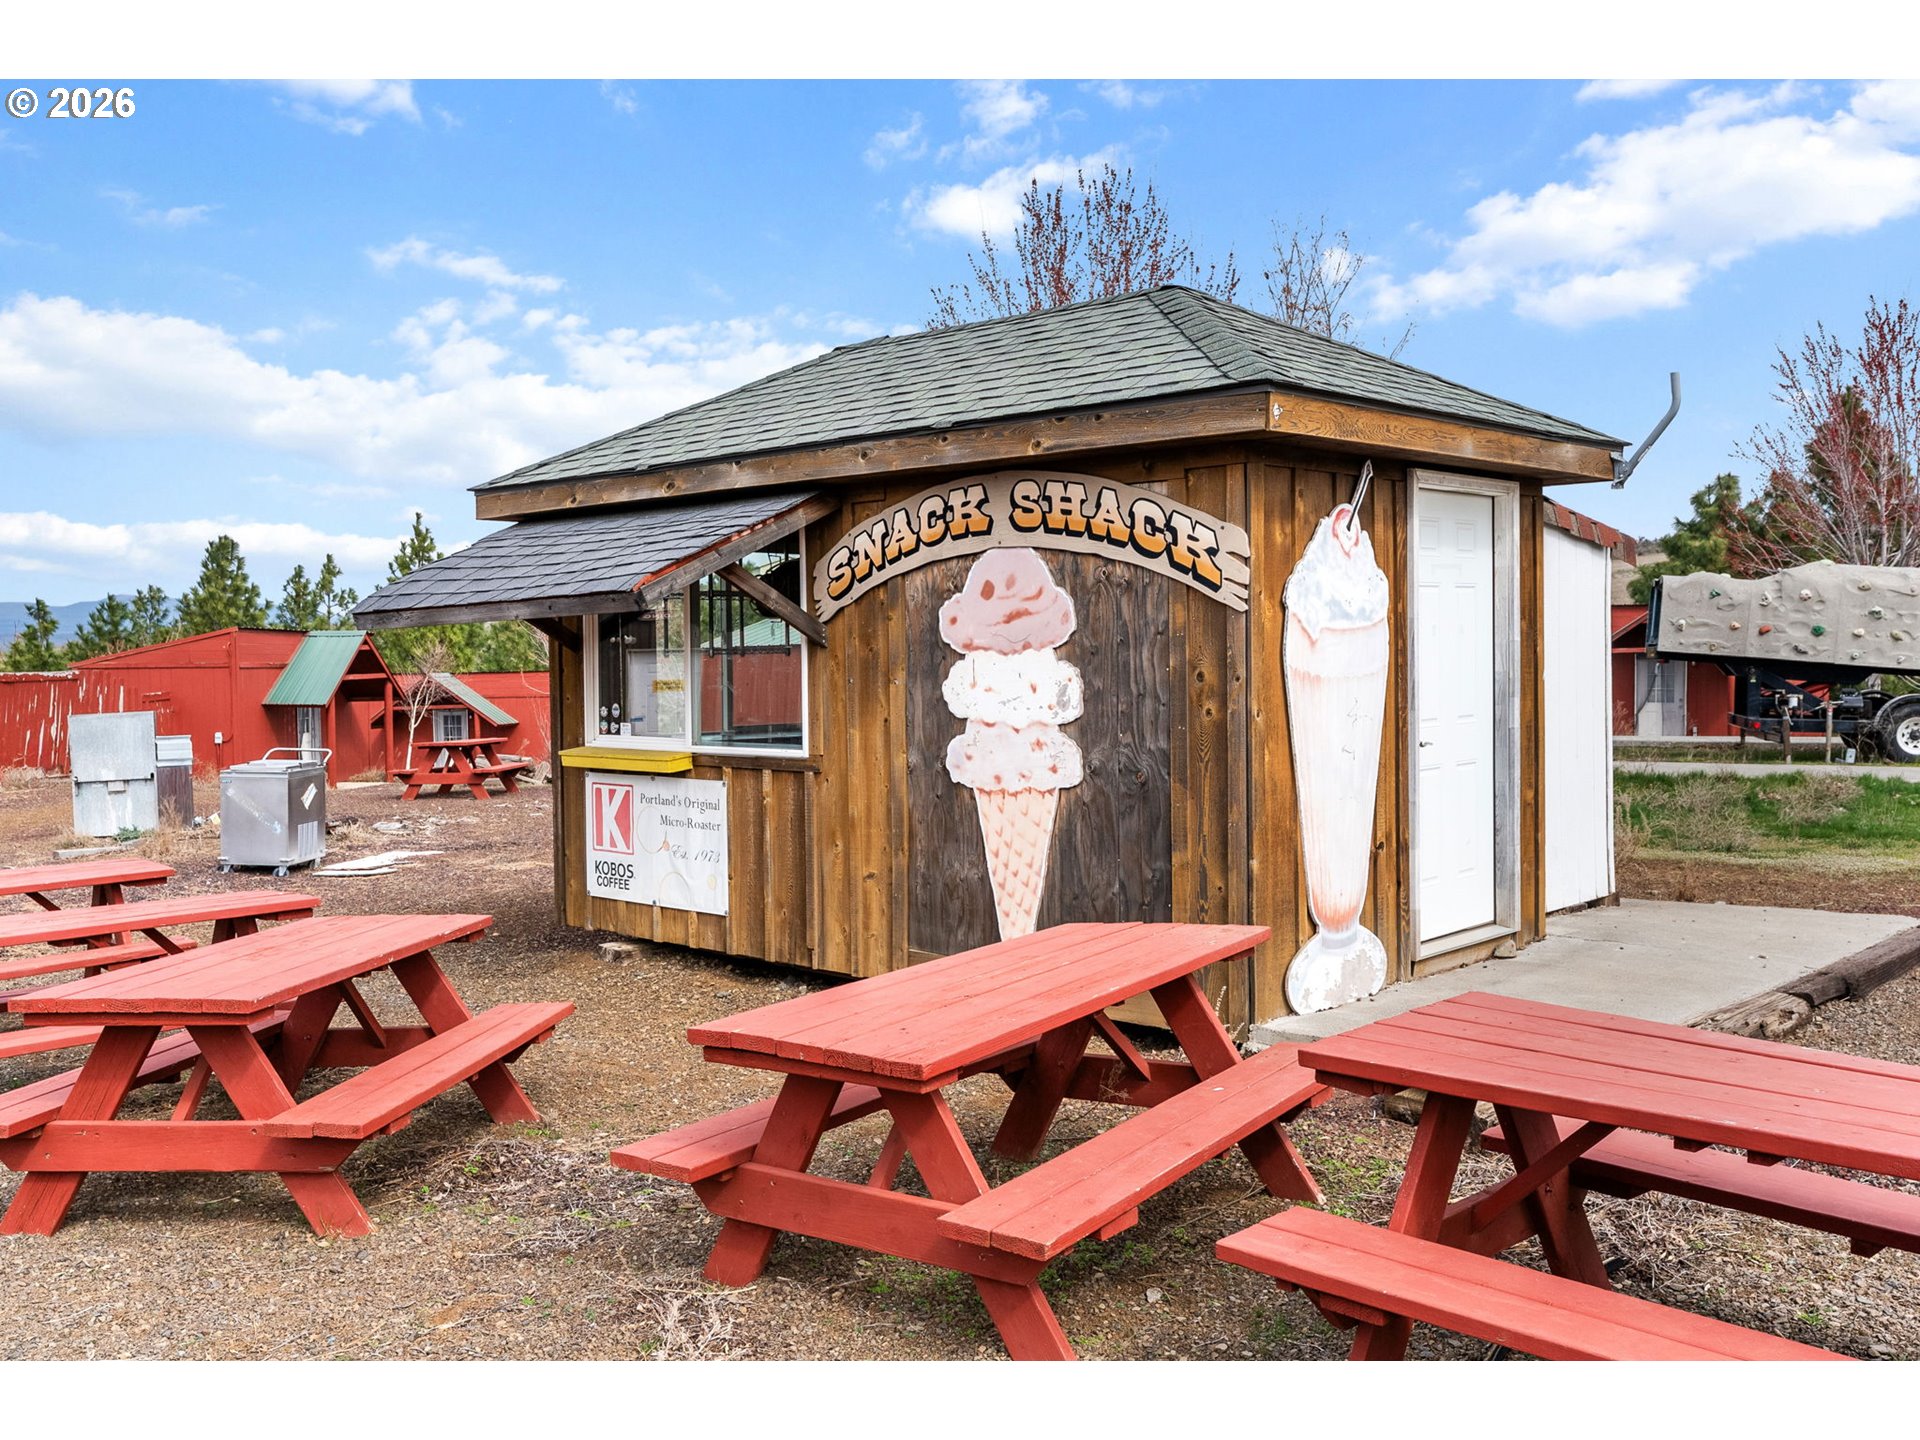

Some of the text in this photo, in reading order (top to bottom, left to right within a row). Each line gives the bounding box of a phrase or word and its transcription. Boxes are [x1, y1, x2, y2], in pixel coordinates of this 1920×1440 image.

[827, 478, 1223, 600] SNACK SHACK
[640, 792, 721, 814] Portland's Original
[660, 814, 721, 832] Micro-Roaster
[594, 859, 634, 879] KOBOS
[596, 875, 630, 891] COFFEE
